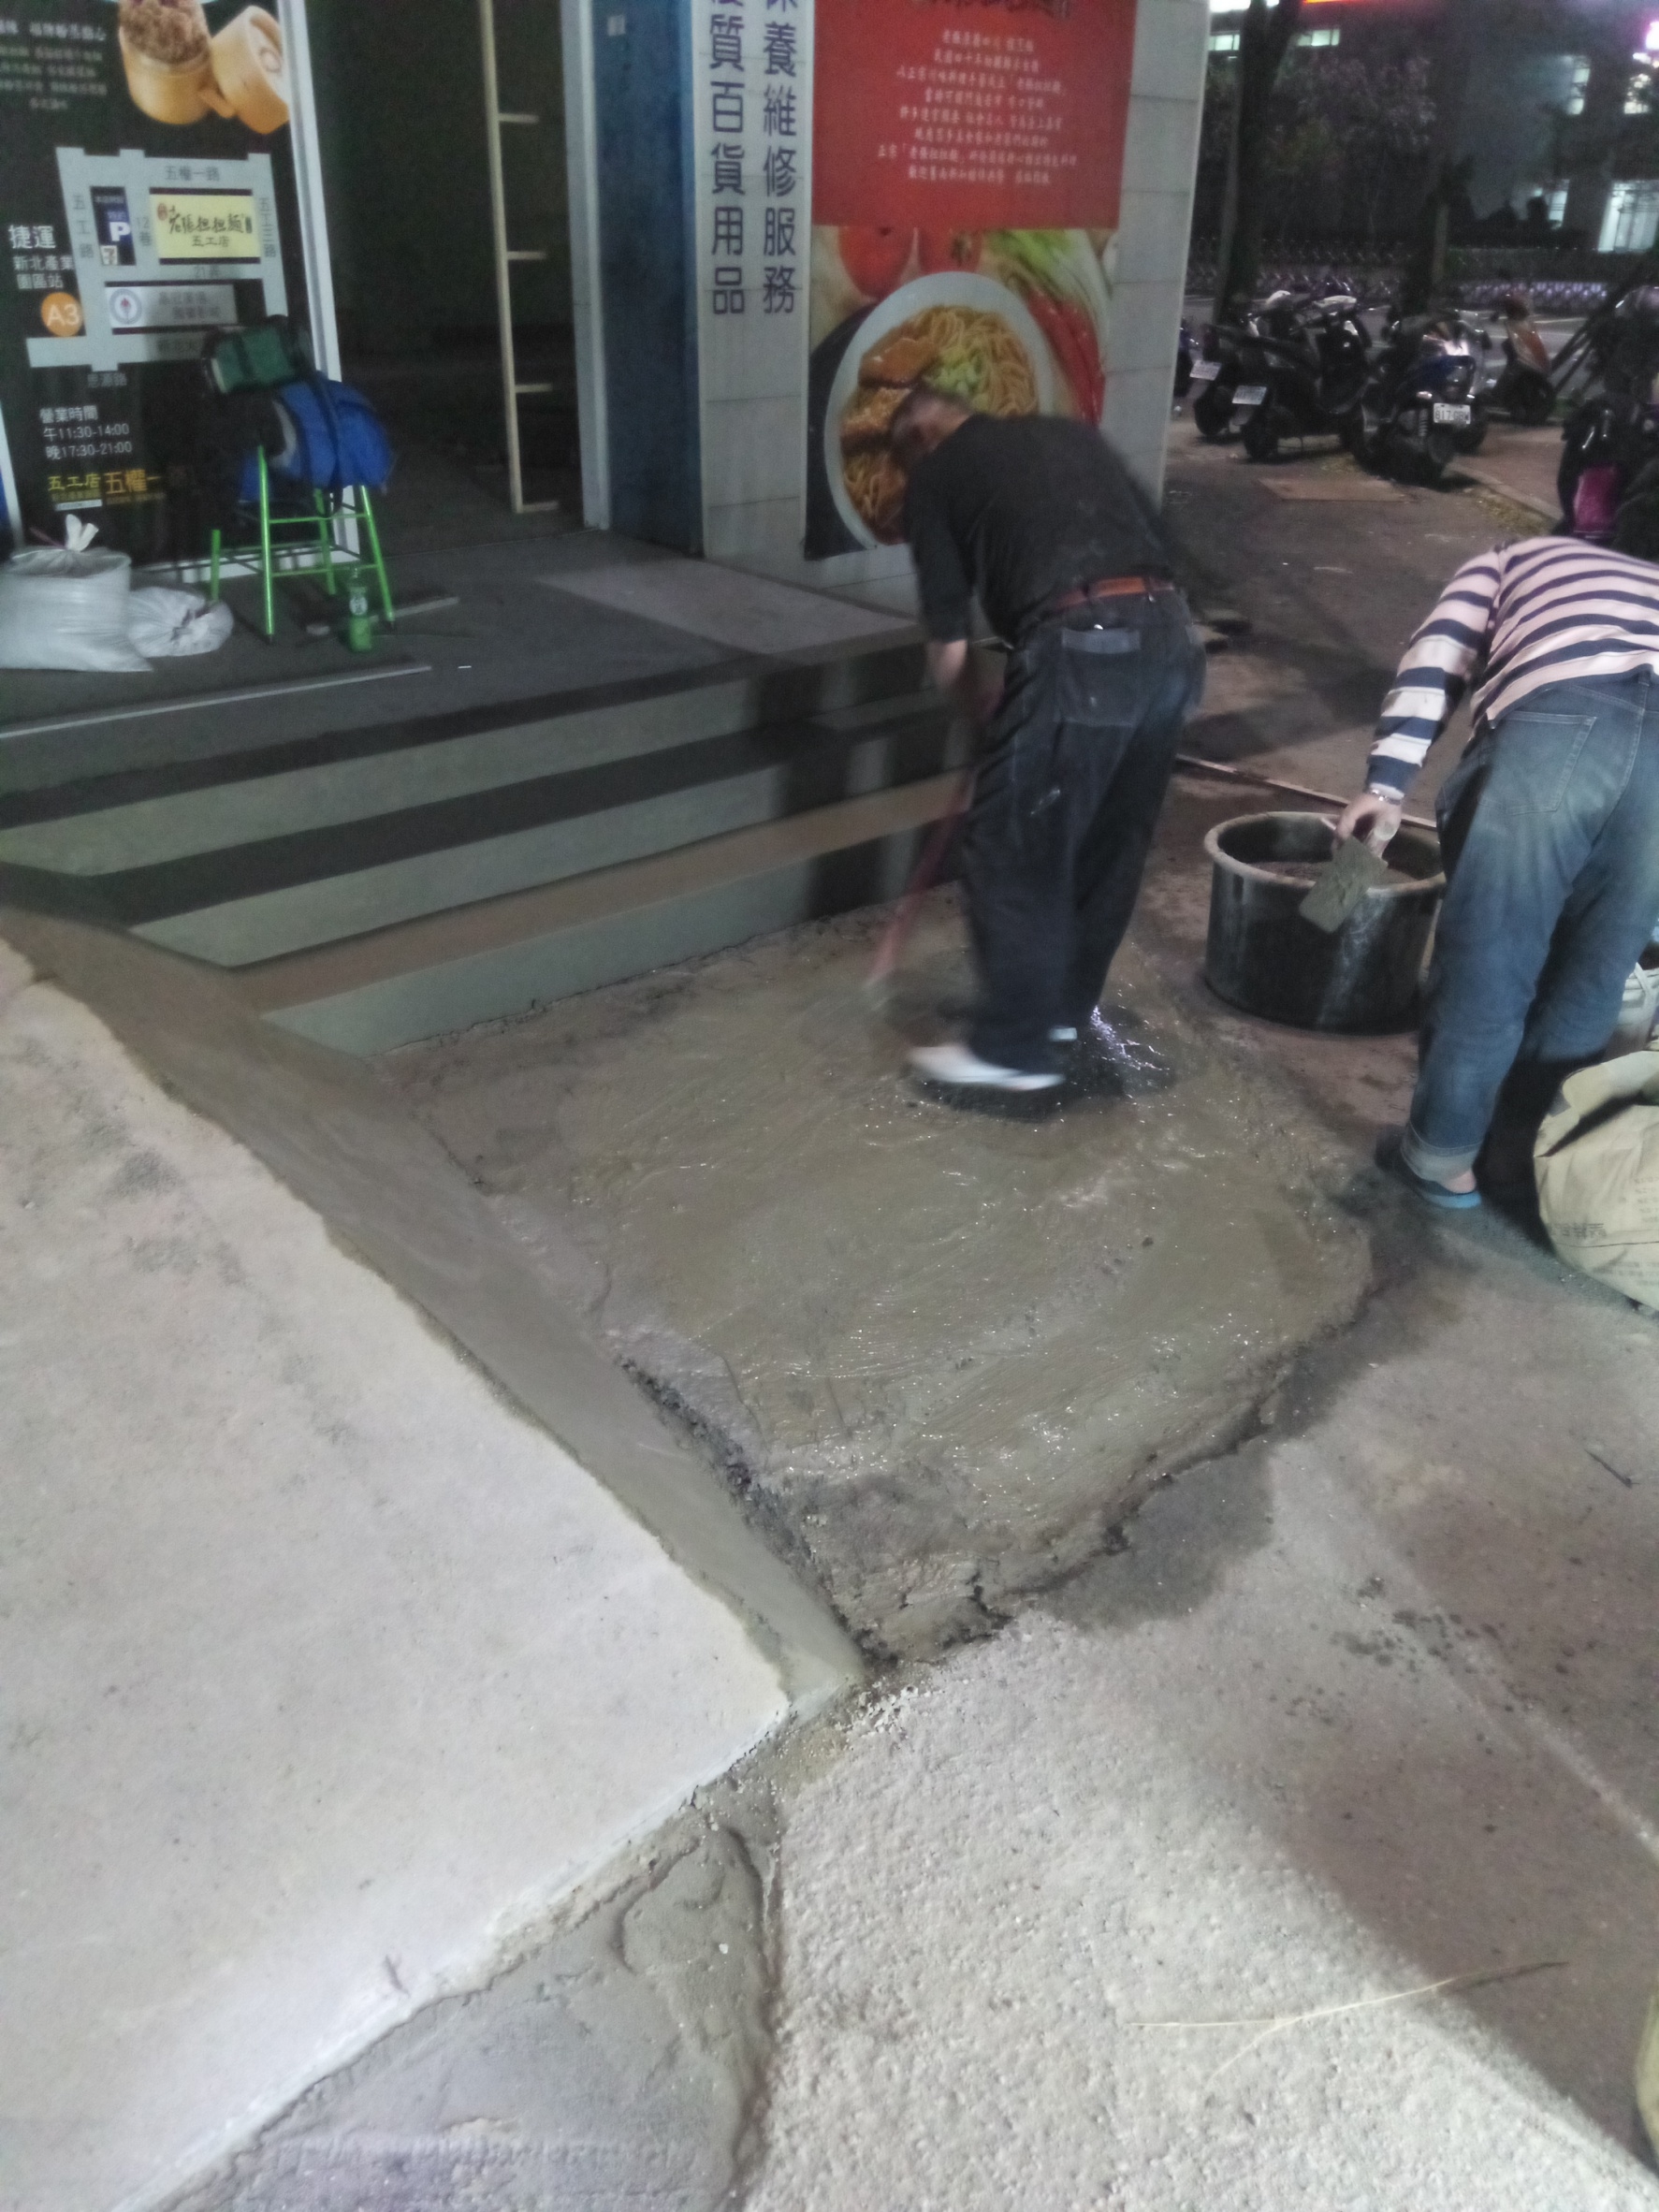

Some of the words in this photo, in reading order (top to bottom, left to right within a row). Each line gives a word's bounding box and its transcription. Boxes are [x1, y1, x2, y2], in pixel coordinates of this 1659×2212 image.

[709, 0, 746, 315] 質百貨用品
[8, 225, 56, 249] 捷運
[109, 221, 131, 241] P
[192, 235, 230, 248] 五工店
[47, 303, 80, 327] A3
[39, 405, 98, 424] 營業時間
[43, 423, 130, 442] 午11:30-14:00
[46, 441, 133, 460] 晚17:30-21:00
[48, 473, 101, 490] 五工店
